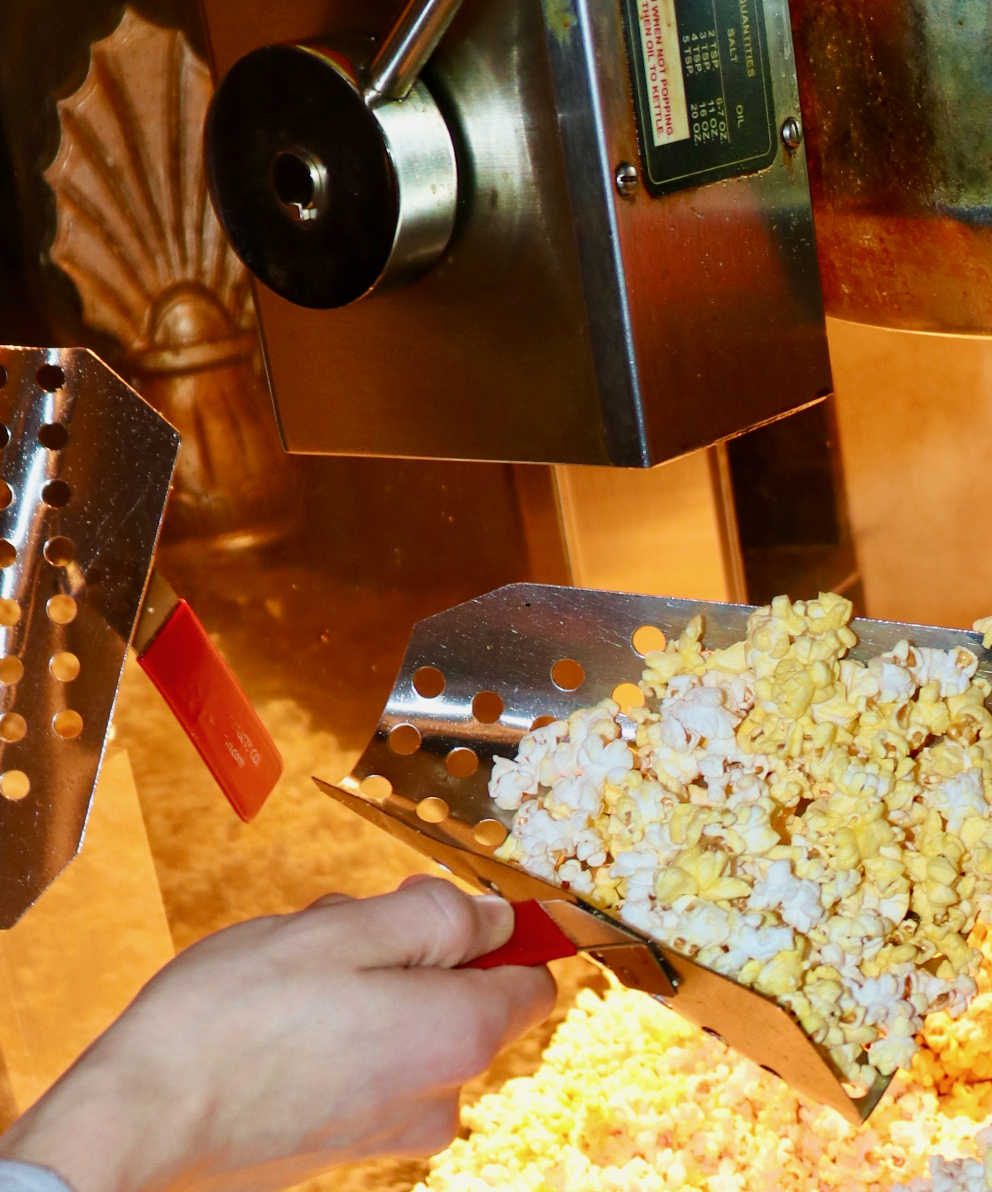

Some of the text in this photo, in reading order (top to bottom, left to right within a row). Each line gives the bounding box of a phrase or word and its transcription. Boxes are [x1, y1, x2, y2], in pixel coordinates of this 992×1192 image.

[642, 2, 653, 36] THEN
[651, 5, 663, 45] WHEN
[646, 40, 654, 62] OIL
[656, 48, 666, 73] NOT
[727, 28, 738, 63] SALT
[649, 64, 657, 82] TO
[682, 35, 702, 146] 5 TSP. 20 OZ.
[691, 33, 711, 144] 4 TSP. 16 OZ.
[700, 31, 719, 141] 3 TSP. 11 OZ.
[709, 41, 719, 71] TSP.
[719, 121, 728, 144] OZ.
[736, 105, 744, 127] OIL
